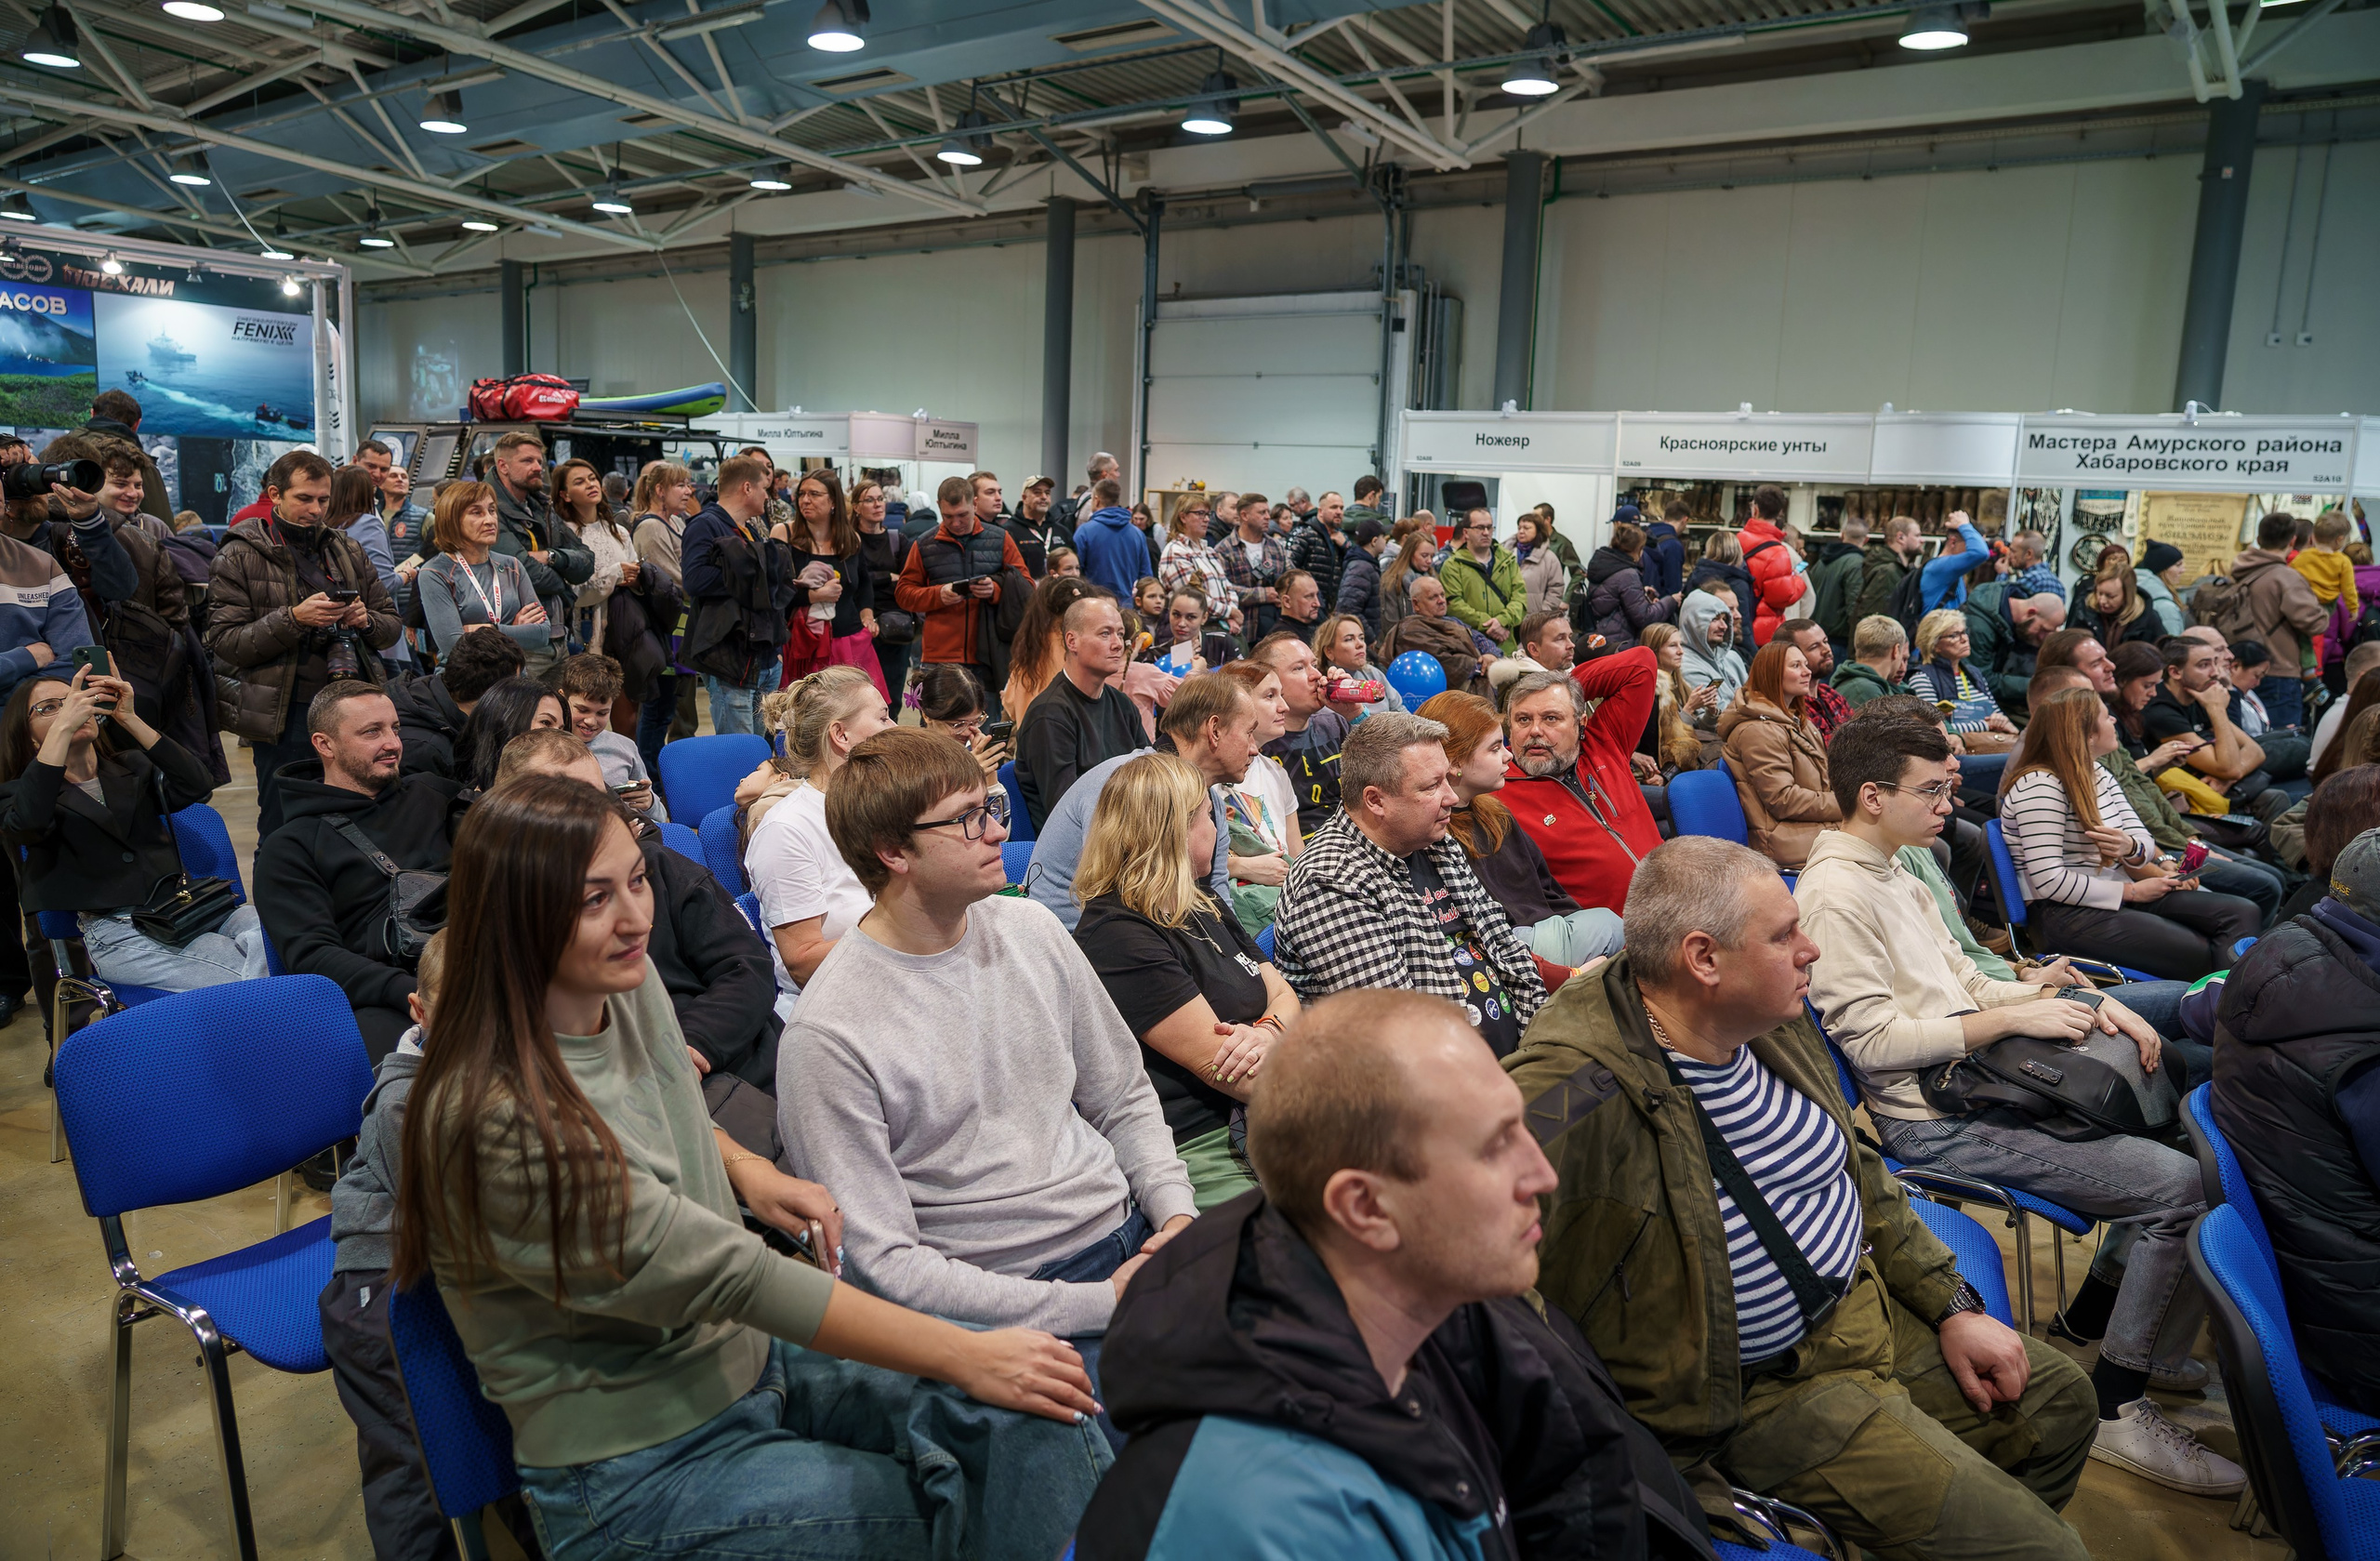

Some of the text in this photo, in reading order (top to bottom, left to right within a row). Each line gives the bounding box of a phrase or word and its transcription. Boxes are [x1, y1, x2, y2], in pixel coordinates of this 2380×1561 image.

[62, 266, 175, 297] ПОЕХАЛИ
[758, 429, 781, 438] Милла
[932, 429, 959, 440] Милла
[1475, 433, 1530, 450] Ножеяр
[925, 439, 967, 450] Юлтыгина
[1659, 435, 1827, 455] Красноярские унты
[2029, 434, 2342, 455] Мастера Амурского района
[2075, 453, 2289, 475] Хабаровского края
